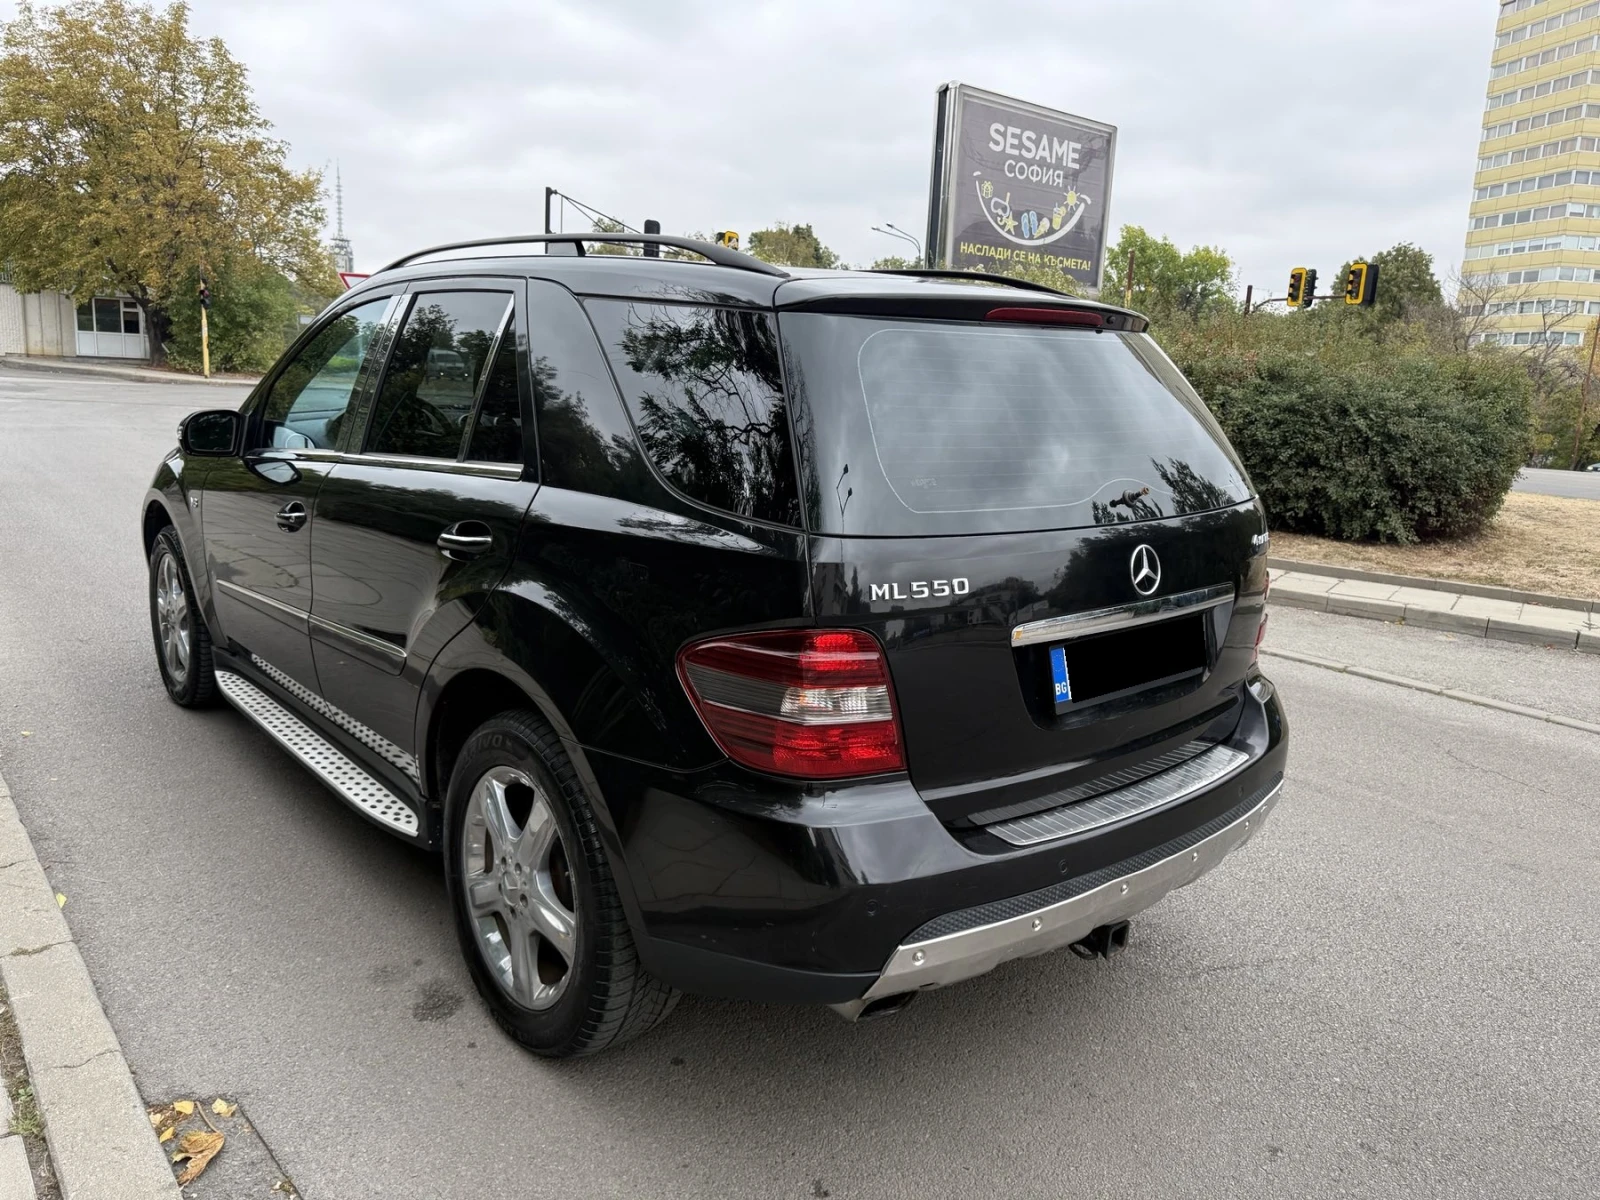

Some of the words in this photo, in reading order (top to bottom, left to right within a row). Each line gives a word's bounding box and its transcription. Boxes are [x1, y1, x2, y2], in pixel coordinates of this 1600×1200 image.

[988, 122, 1082, 170] SESAME
[1004, 159, 1064, 187] СОФИЯ
[960, 241, 1011, 261] НАСЛАДИ
[1013, 250, 1025, 261] СЕ
[1028, 251, 1041, 265] НА
[1044, 254, 1091, 271] КЪСМЕТА!
[869, 577, 970, 601] ML550
[1055, 681, 1067, 696] BG
